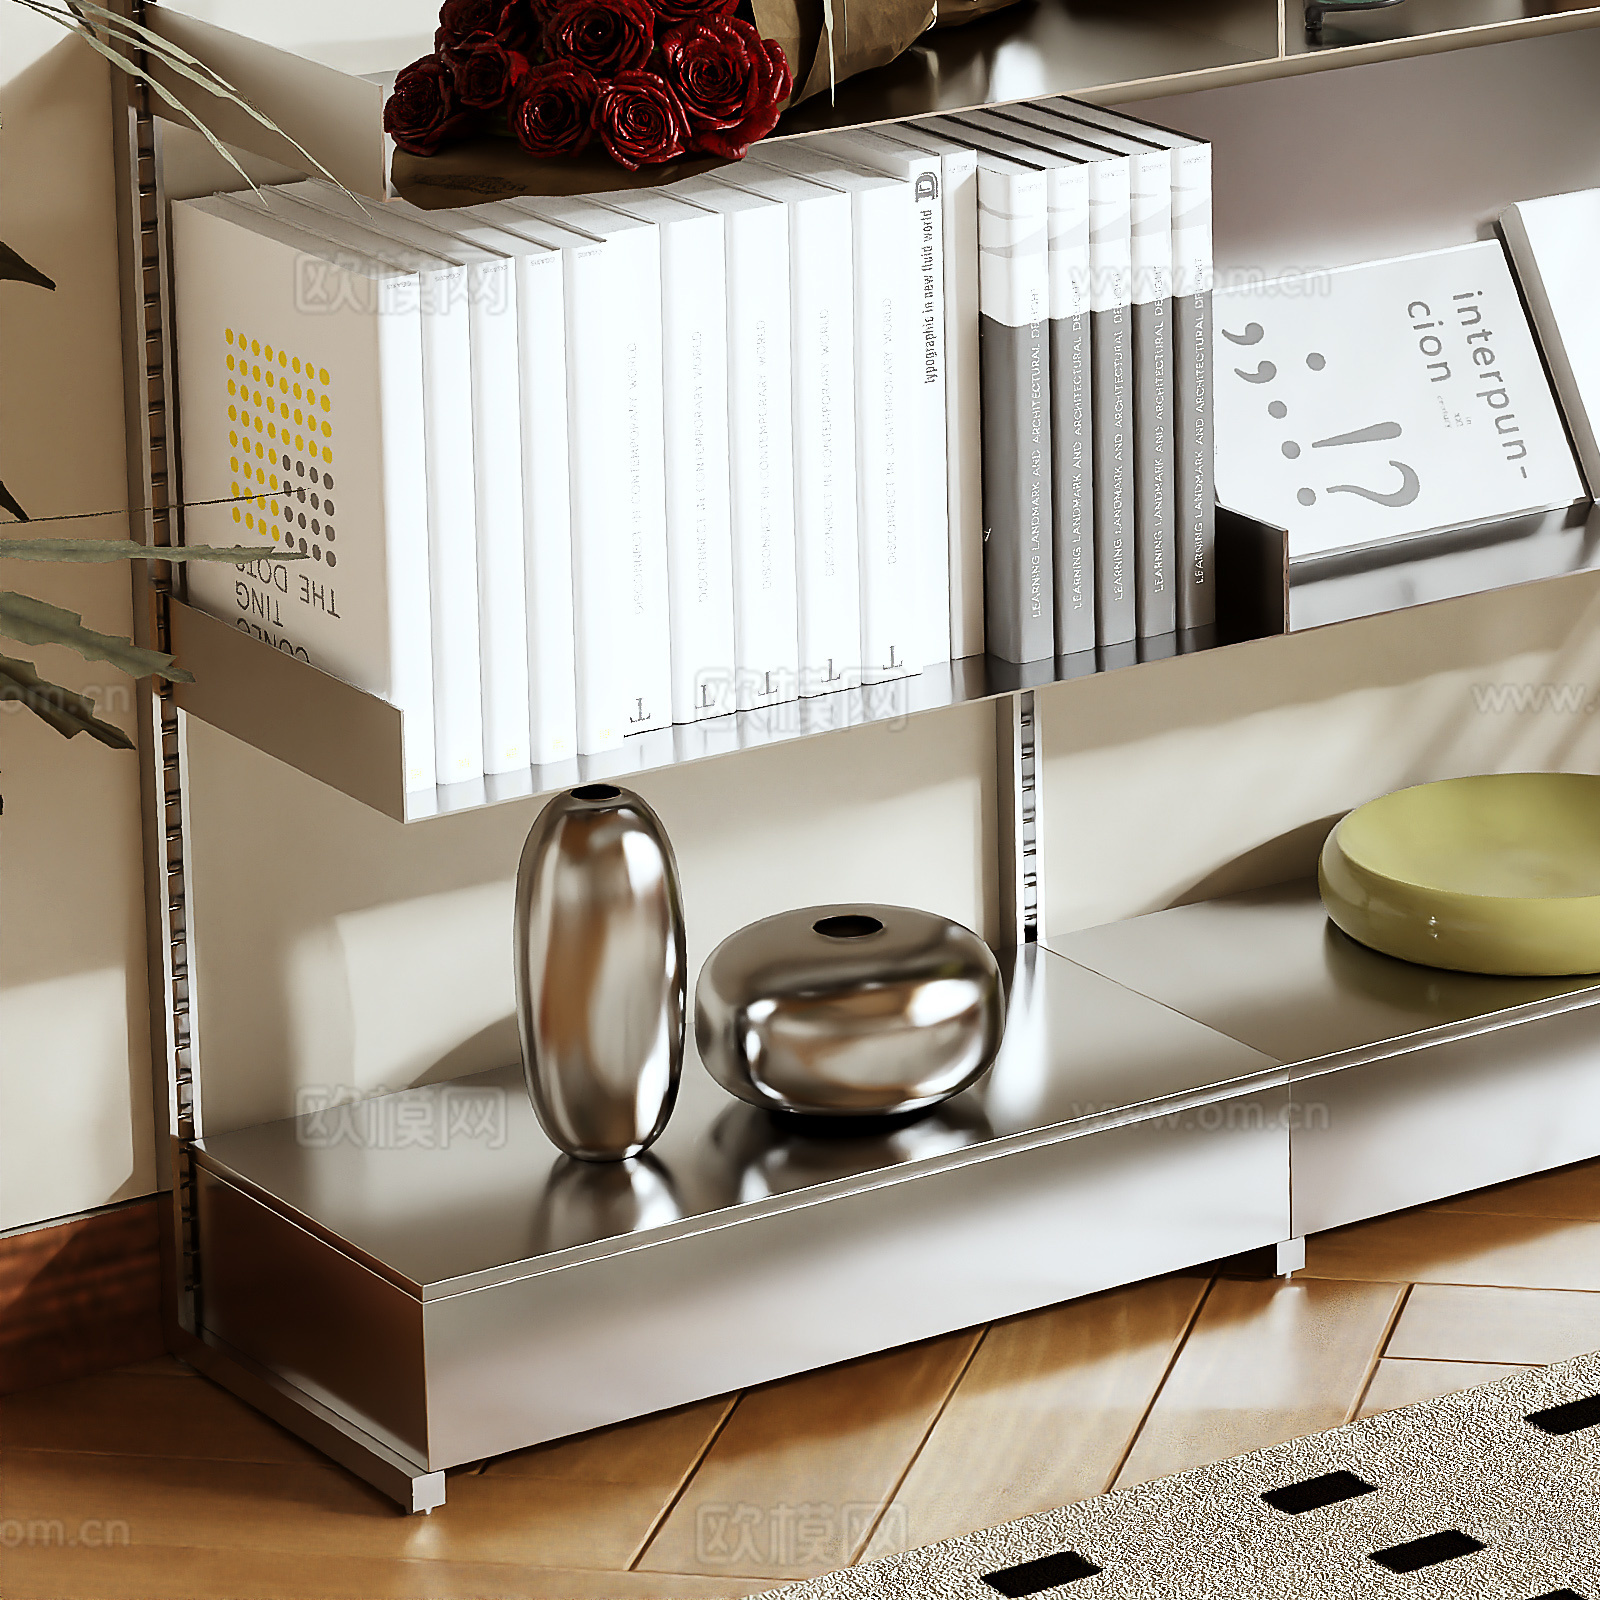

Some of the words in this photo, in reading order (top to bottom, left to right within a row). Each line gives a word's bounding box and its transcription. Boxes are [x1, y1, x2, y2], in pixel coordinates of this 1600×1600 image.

[920, 210, 932, 242] world
[922, 302, 934, 312] in
[923, 275, 934, 298] new
[922, 317, 938, 383] typographic
[1407, 301, 1452, 382] cion
[1452, 291, 1529, 479] interpun-
[1114, 434, 1123, 460] AND
[1154, 426, 1164, 452] AND
[1195, 419, 1204, 445] AND
[1031, 450, 1041, 476] AND
[1073, 442, 1082, 468] AND
[1113, 466, 1122, 534] LANDMARK
[1154, 458, 1163, 526] LANDMARK
[1195, 451, 1204, 518] LANDMARK
[1031, 482, 1041, 550] LANDMARK
[1072, 474, 1082, 542] LANDMARK
[1113, 539, 1123, 600] LEARNING
[1154, 531, 1163, 592] LEARNING
[1194, 523, 1204, 584] LEARNING
[299, 574, 340, 618] THE
[1031, 556, 1041, 618] LEARNING
[1072, 547, 1082, 609] LEARNING
[235, 581, 283, 627] TING
[821, 659, 840, 683] T
[882, 646, 902, 670] T
[695, 685, 715, 709] T
[758, 672, 777, 696] T
[630, 698, 650, 723] T
